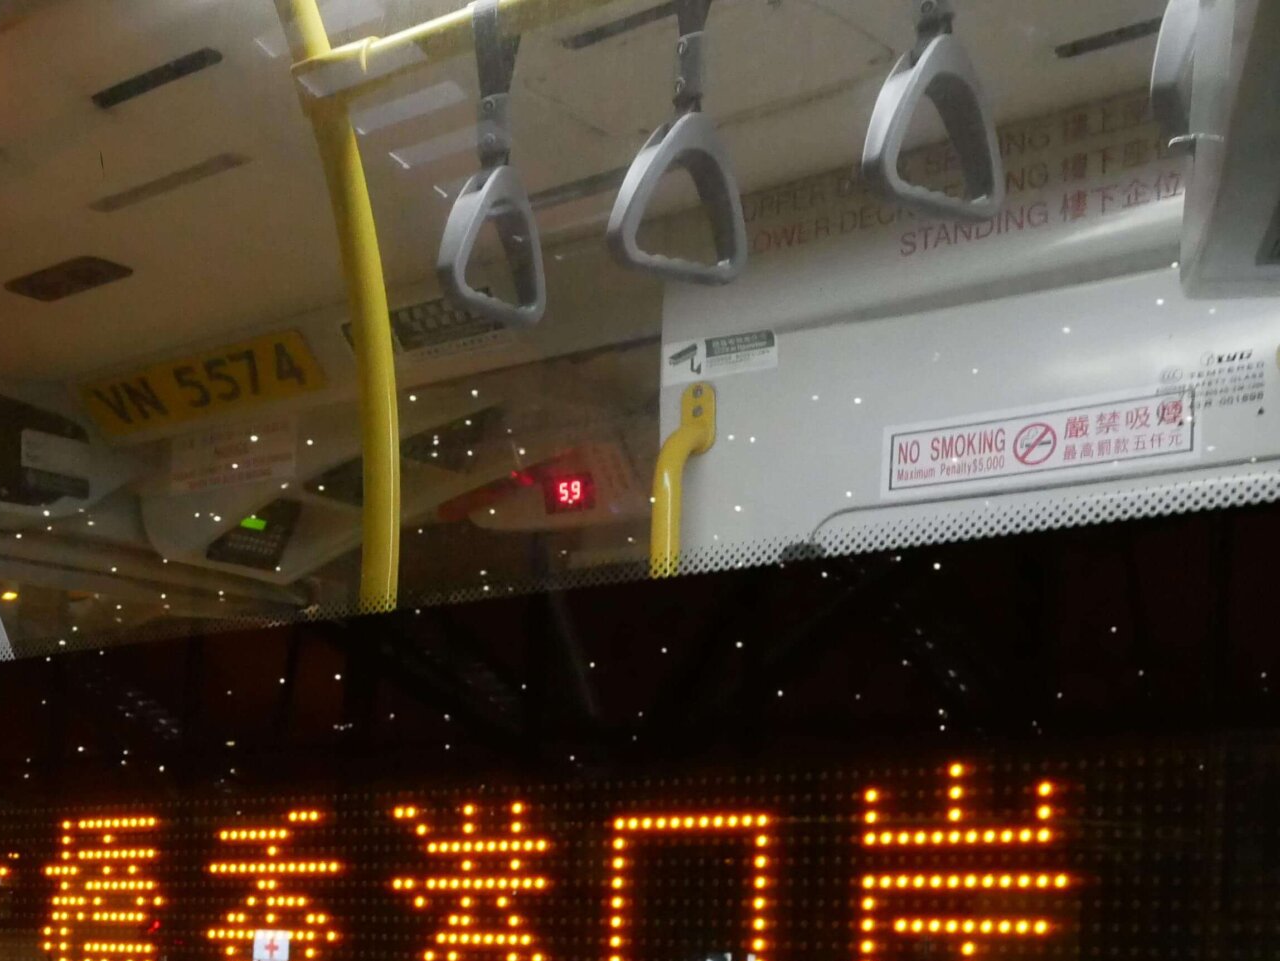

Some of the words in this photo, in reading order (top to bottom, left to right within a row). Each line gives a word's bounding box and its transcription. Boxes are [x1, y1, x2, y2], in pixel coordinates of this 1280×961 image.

[900, 202, 1048, 256] STANDING
[92, 377, 169, 425] VN
[173, 342, 307, 408] 5574
[898, 440, 921, 465] NO
[930, 427, 1006, 461] SMOKING
[558, 479, 582, 502] 59
[896, 467, 936, 481] Maximum
